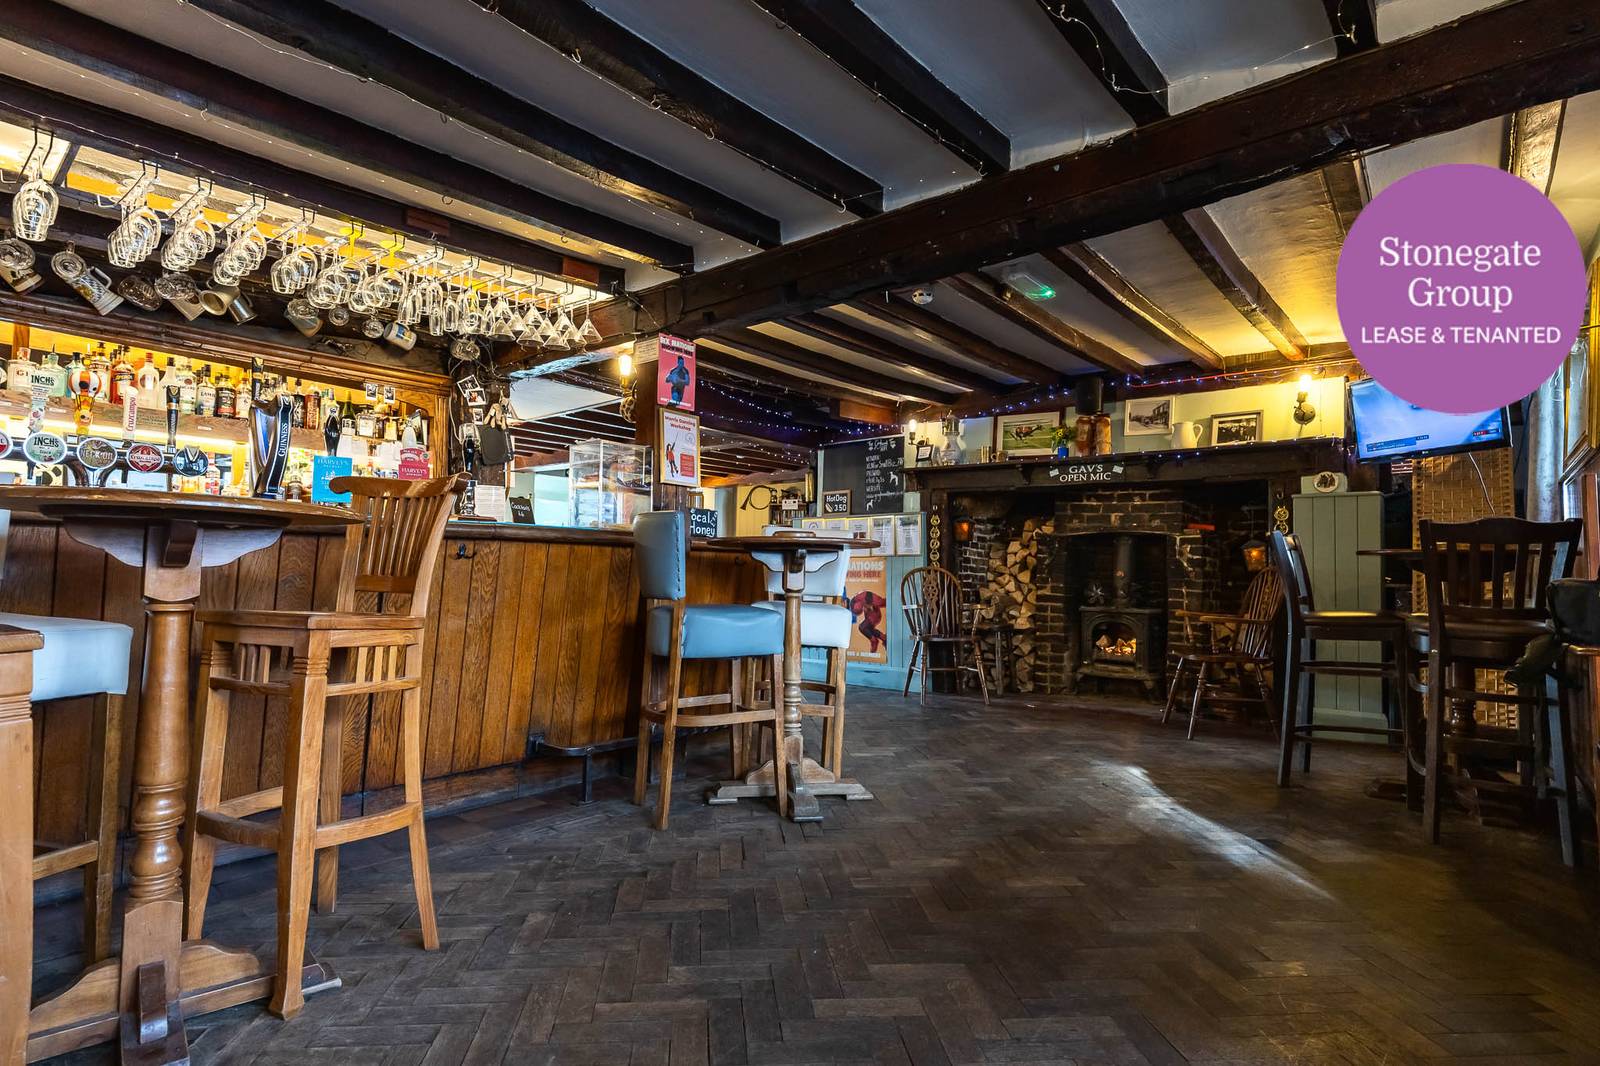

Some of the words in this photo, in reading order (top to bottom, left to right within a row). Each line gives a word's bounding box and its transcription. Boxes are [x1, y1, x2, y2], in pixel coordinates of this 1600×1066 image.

[278, 422, 288, 457] GUINNESS
[1069, 464, 1103, 474] GAV'S
[1060, 474, 1087, 482] OPEN
[1090, 472, 1111, 481] MIC
